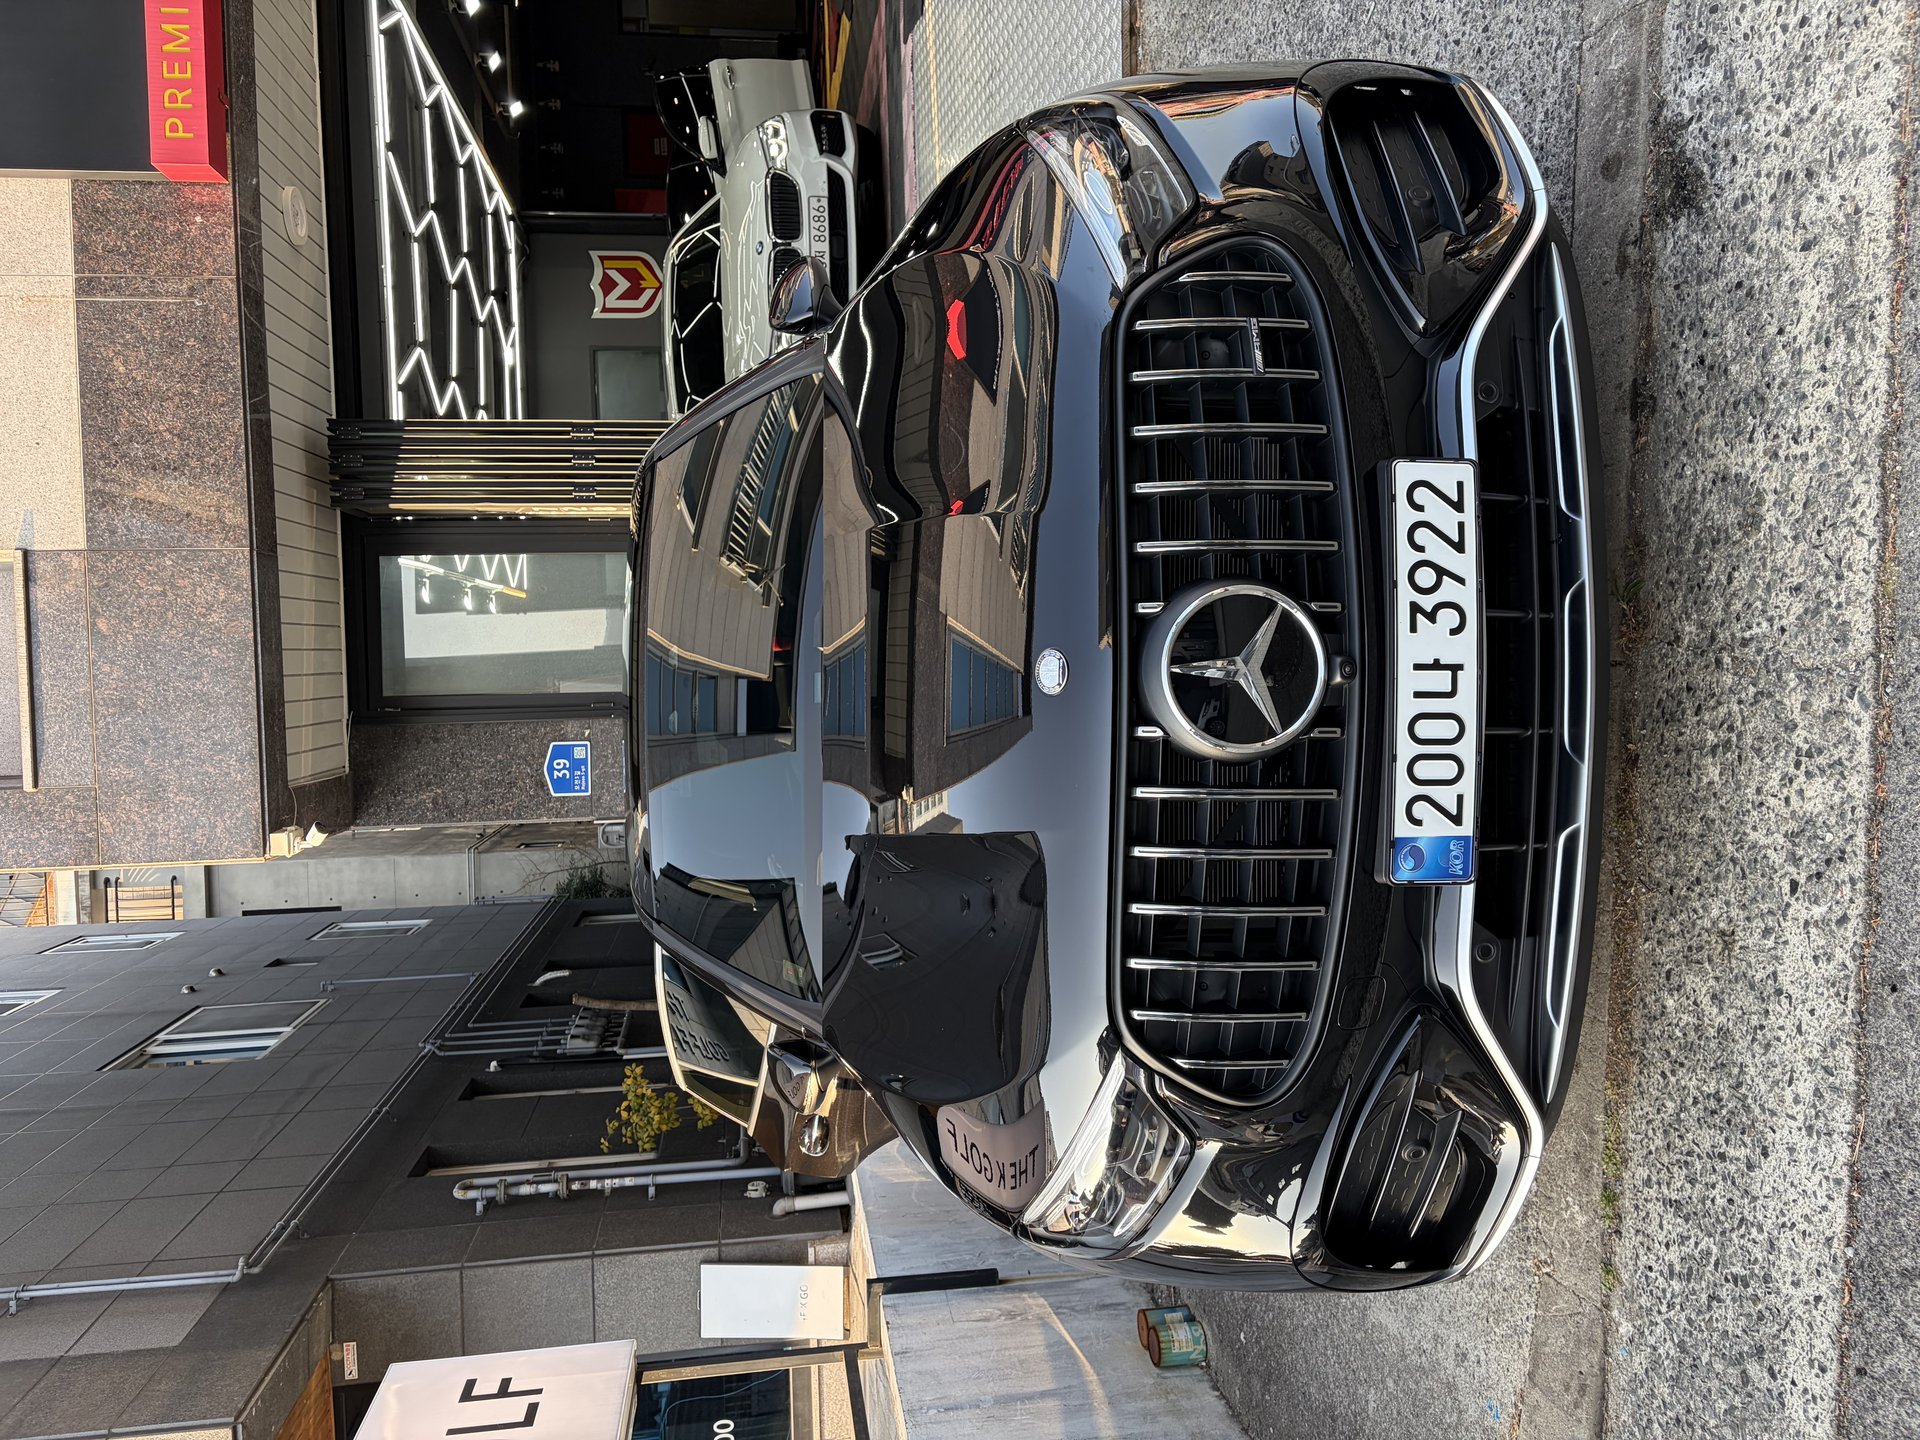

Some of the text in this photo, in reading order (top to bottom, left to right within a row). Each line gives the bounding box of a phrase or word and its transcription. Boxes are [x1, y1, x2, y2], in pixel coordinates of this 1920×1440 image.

[159, 7, 194, 139] PREMI
[812, 205, 826, 242] 8686
[1405, 479, 1467, 828] 200나 3922
[553, 759, 569, 779] 39
[1448, 840, 1464, 875] KOR
